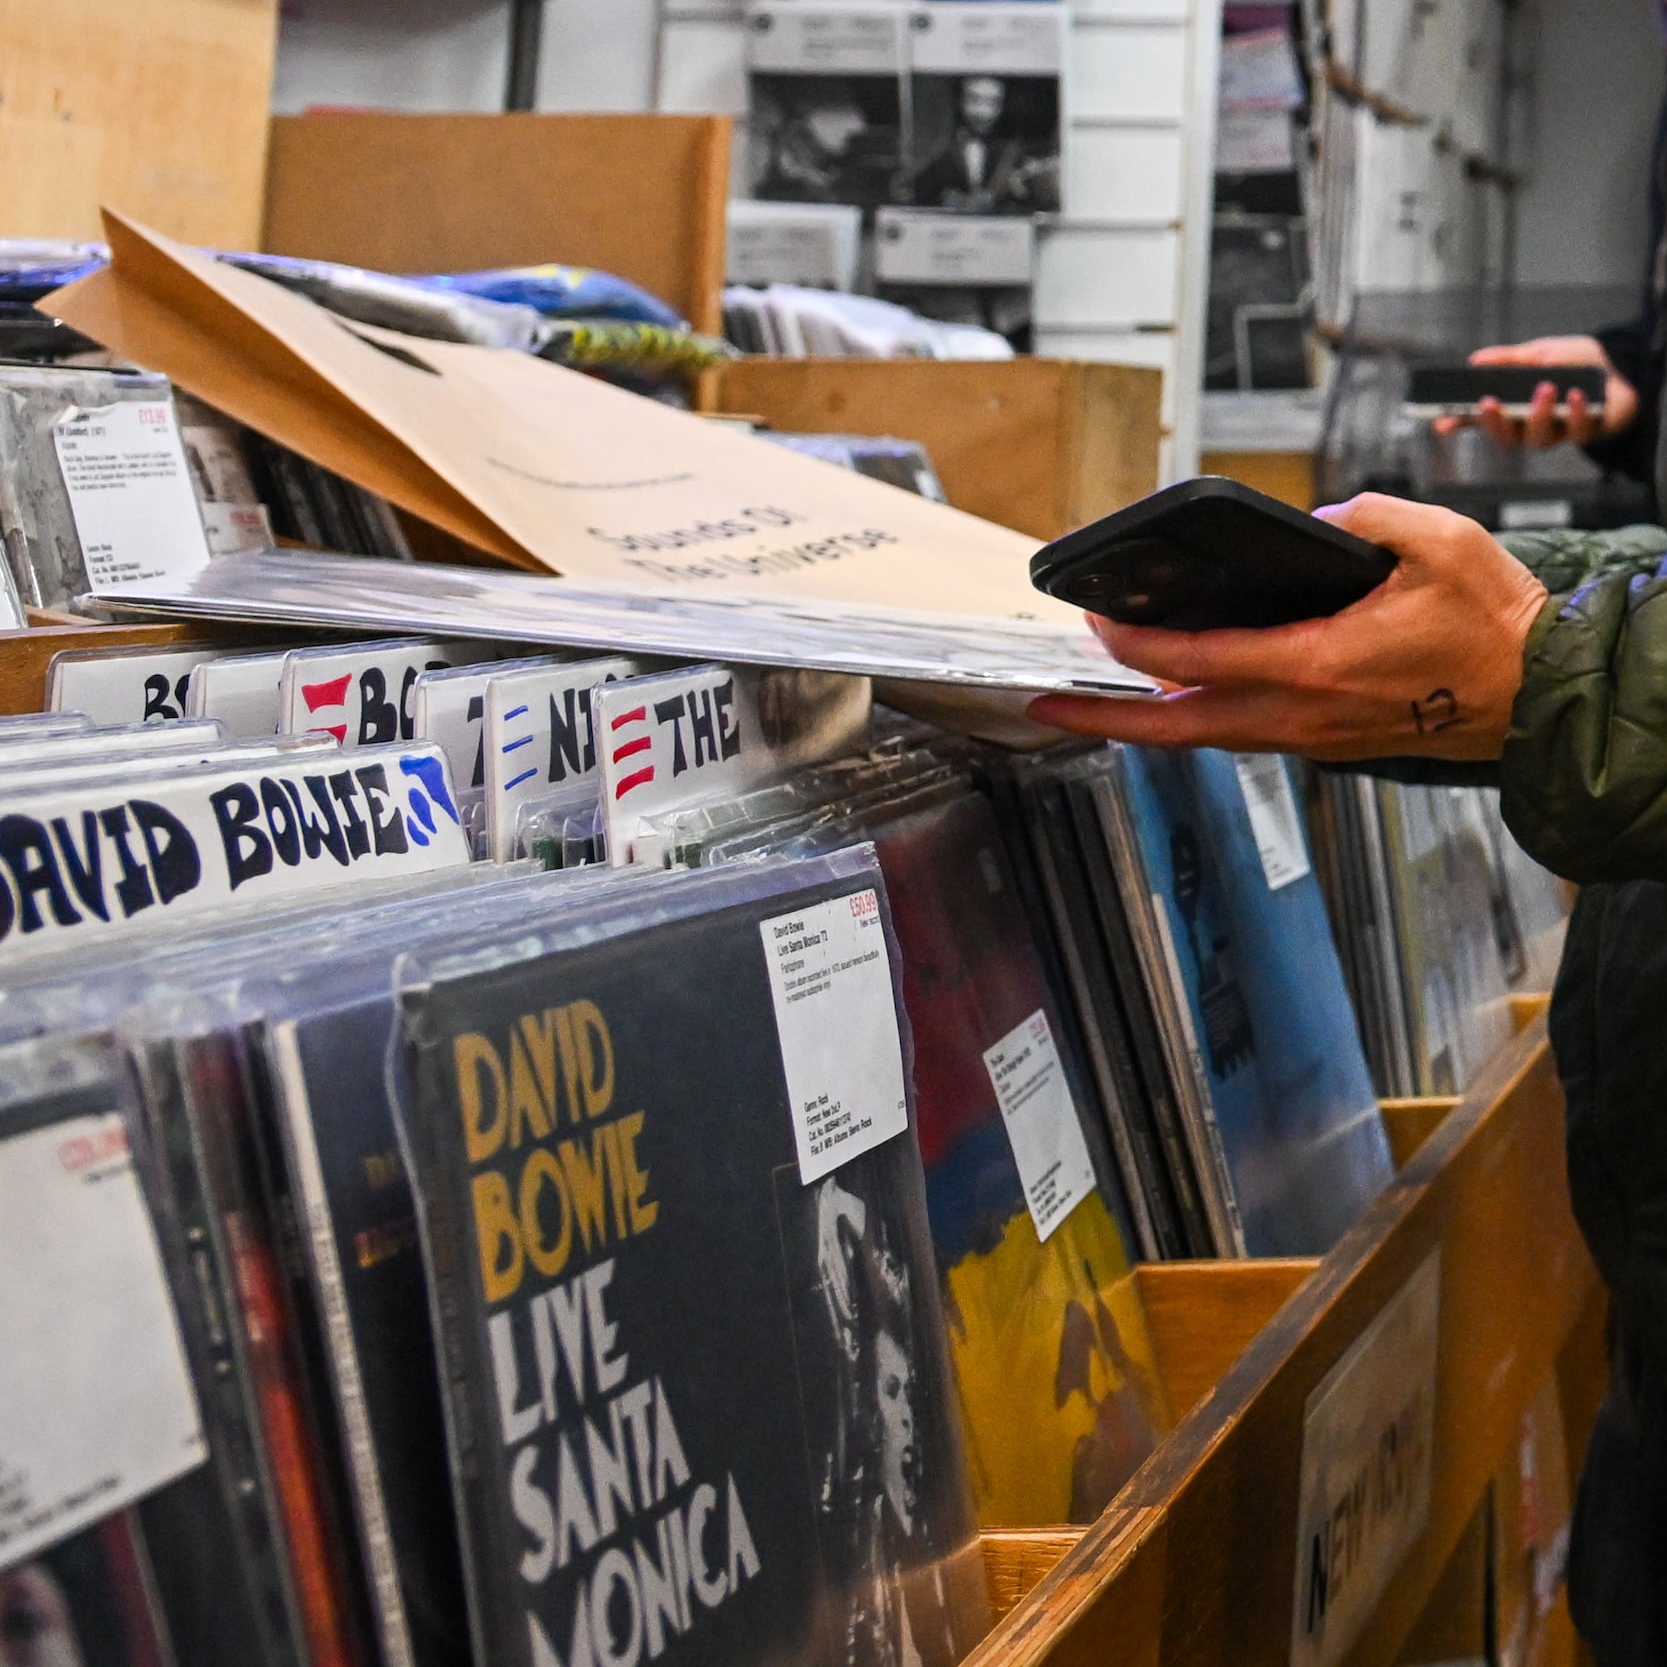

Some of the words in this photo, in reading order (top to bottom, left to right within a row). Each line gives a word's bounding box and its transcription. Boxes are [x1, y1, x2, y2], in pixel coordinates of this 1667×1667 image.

[653, 677, 741, 778] THE
[209, 762, 408, 892] BOWIE
[453, 998, 615, 1163] DAVID
[470, 1109, 660, 1303] BOWIE
[487, 1258, 629, 1444] LIVE
[510, 1373, 692, 1583] SANTA
[526, 1470, 762, 1667] MONICA
